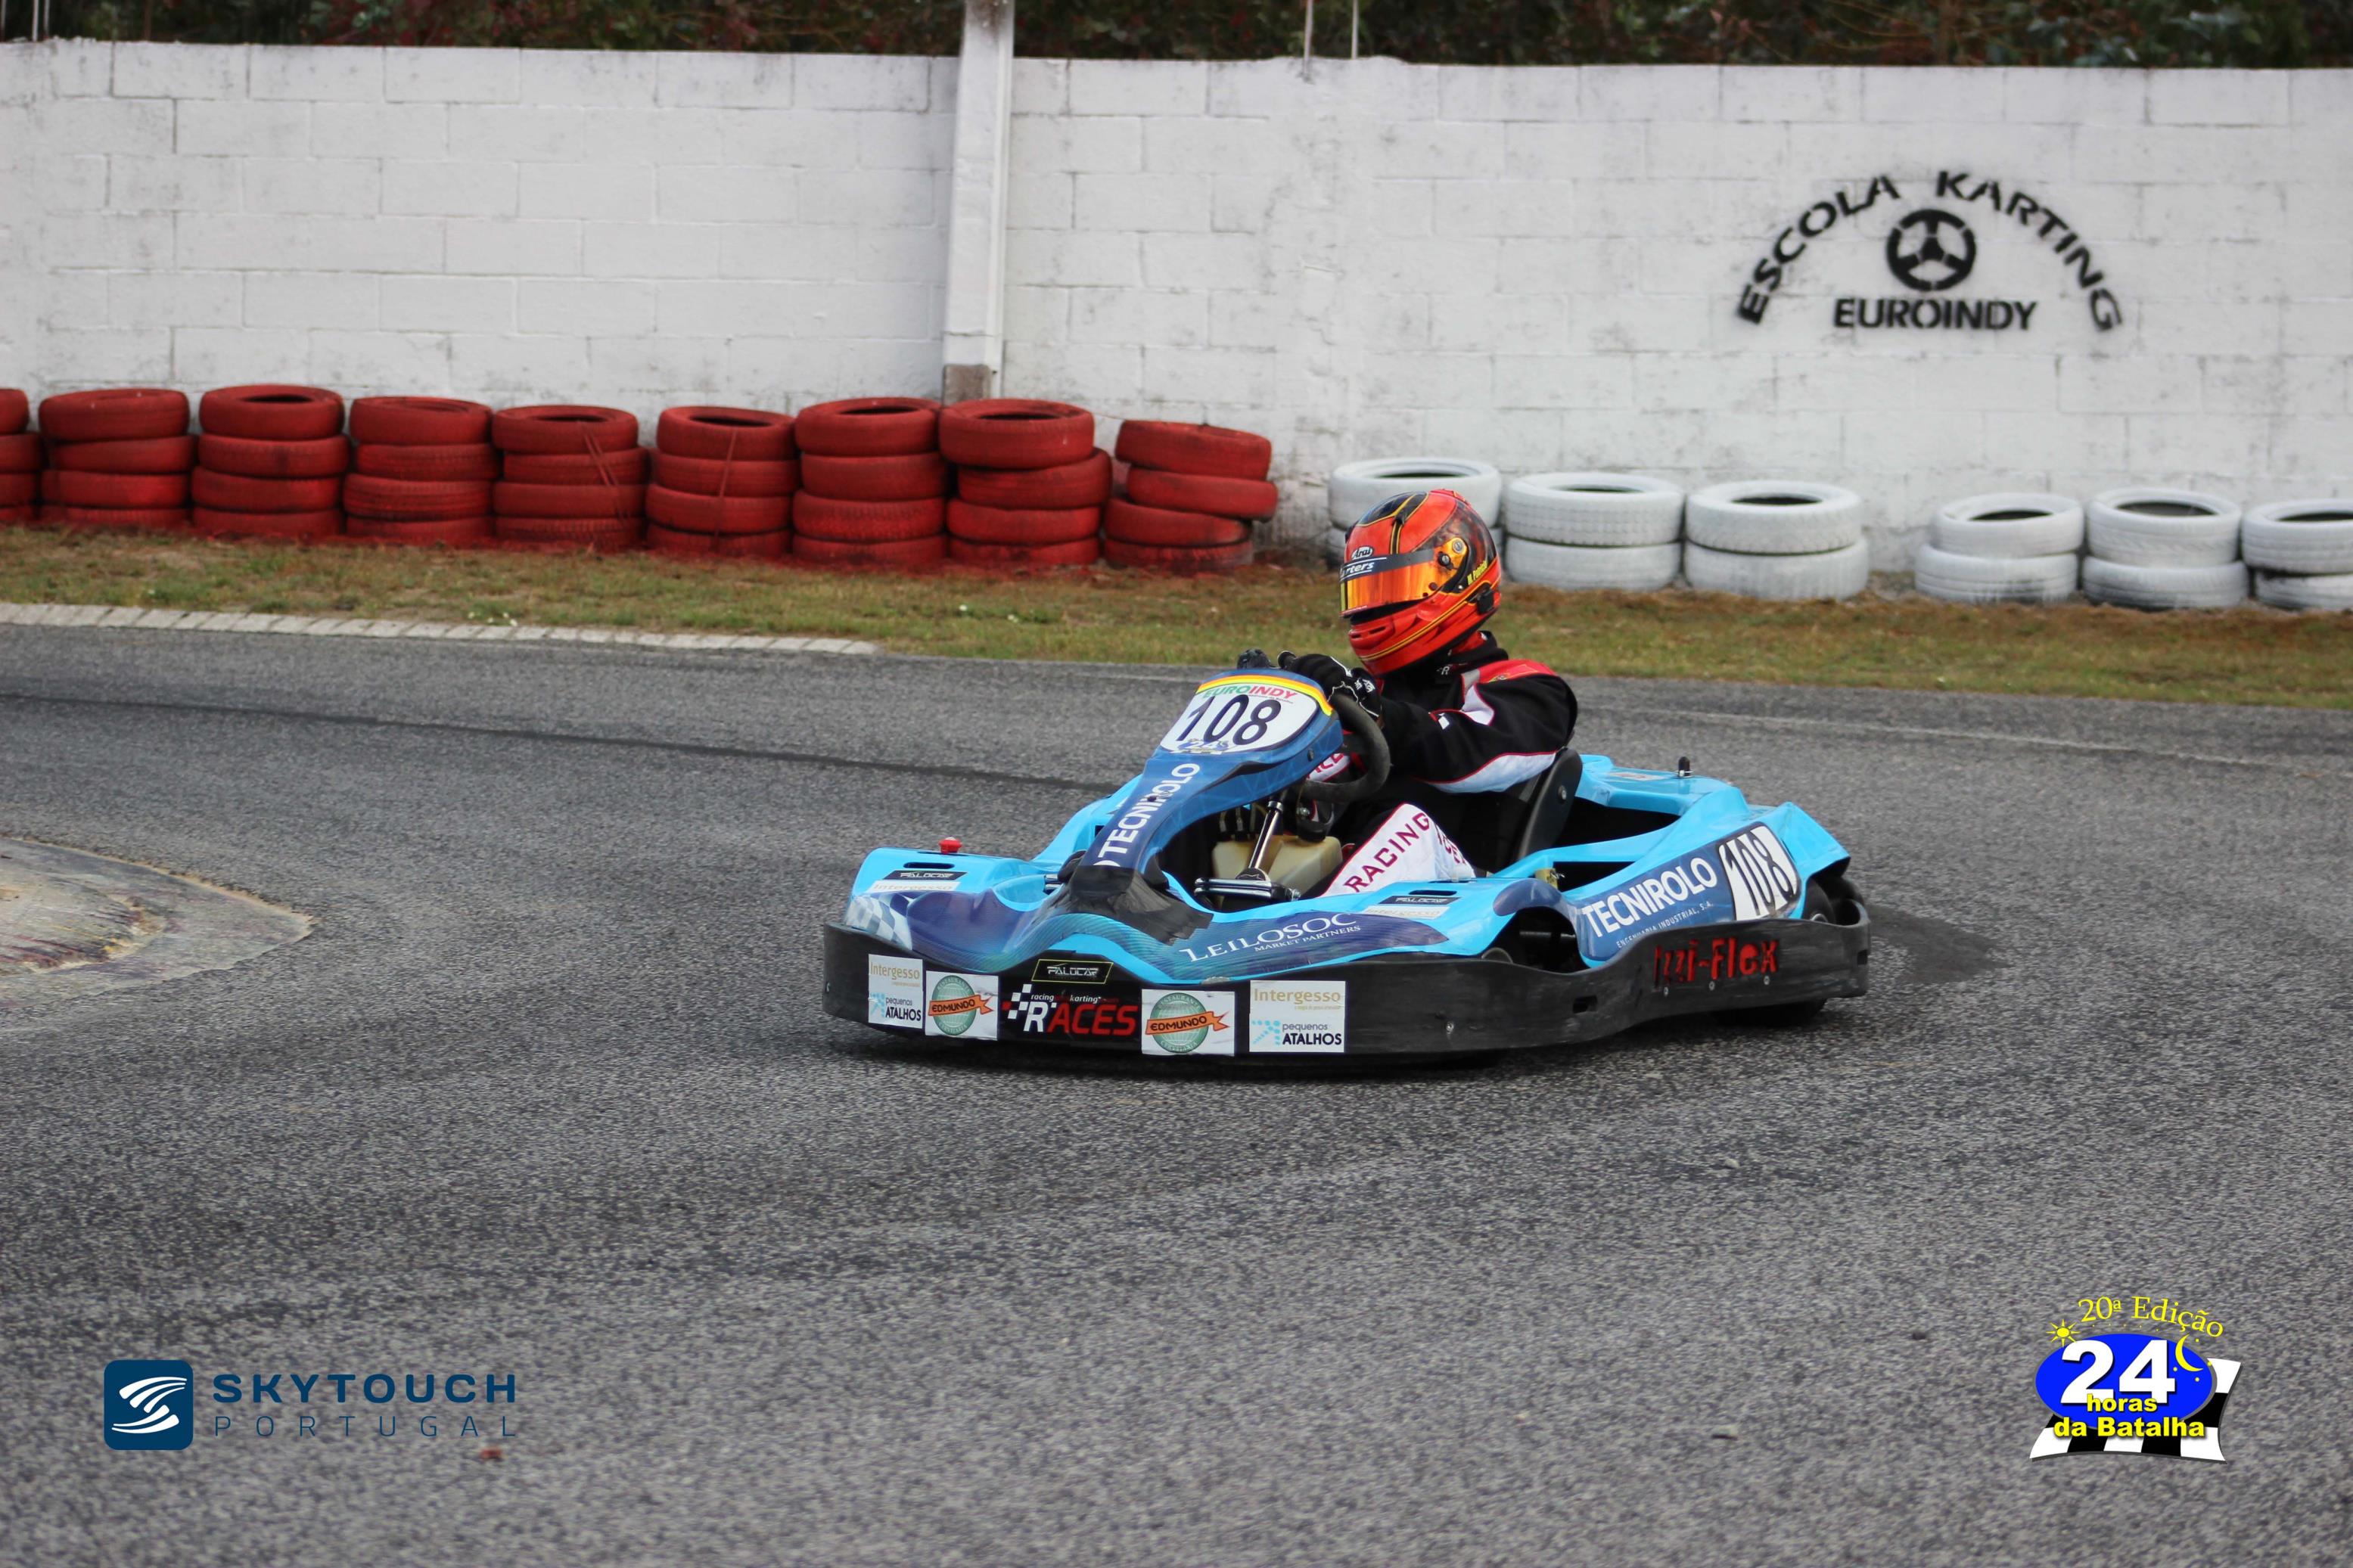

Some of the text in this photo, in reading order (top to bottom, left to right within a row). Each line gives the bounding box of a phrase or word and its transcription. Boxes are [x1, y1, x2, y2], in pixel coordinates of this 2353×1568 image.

[1736, 170, 2123, 333] ESCOLA KARTING
[1832, 298, 2038, 331] EUROINDY
[1352, 546, 1373, 558] Arai
[1202, 685, 1298, 699] EUROINDY
[1176, 694, 1282, 746] 108
[1344, 812, 1430, 893] RACING
[1724, 831, 1795, 916] 108
[1581, 857, 1718, 937] TECNIROLO
[1179, 913, 1357, 962] LEILOSOC
[1254, 925, 1361, 952] MARKET PARTNERS
[870, 962, 920, 980] Intergesso
[885, 997, 912, 1006] pequenos
[931, 998, 975, 1013] EDMUNDO
[1254, 989, 1341, 1004] Intergesso
[885, 1006, 922, 1021] ATALHOS
[1023, 1001, 1139, 1036] RACES
[1150, 1015, 1208, 1031] EDMUNDO
[1282, 1023, 1328, 1032] pequenos
[1282, 1032, 1342, 1045] ATALHOS
